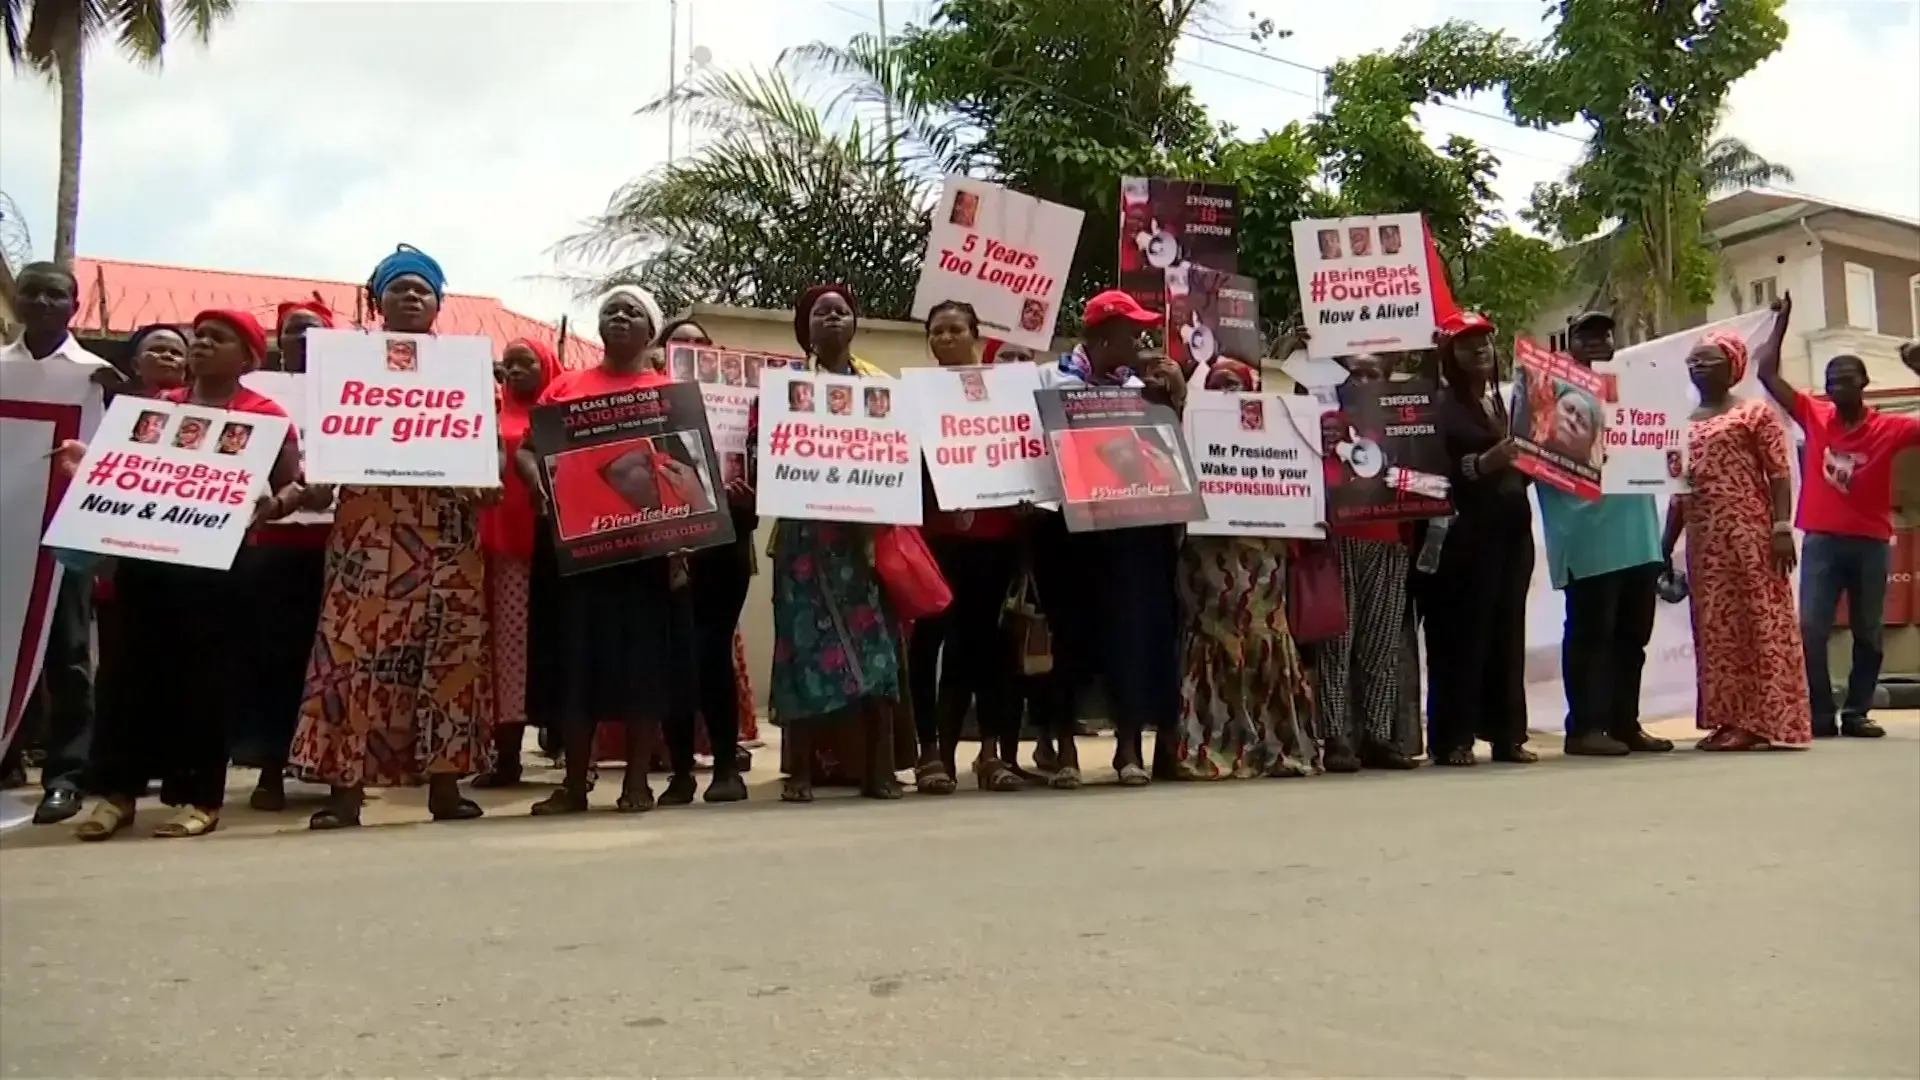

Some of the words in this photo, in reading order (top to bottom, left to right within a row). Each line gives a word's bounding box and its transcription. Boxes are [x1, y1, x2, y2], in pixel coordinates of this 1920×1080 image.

[962, 233, 979, 253] 5
[984, 237, 1039, 270] Years
[938, 249, 972, 276] Too
[976, 261, 1053, 296] Long!!!
[1319, 308, 1355, 325] Now
[1360, 305, 1371, 321] &
[1376, 302, 1419, 319] Alive!
[340, 380, 465, 409] Rescue
[610, 394, 636, 406] FIND
[321, 414, 383, 436] our
[391, 412, 483, 442] girls!
[941, 413, 1030, 438] Rescue
[1615, 409, 1626, 426] 5
[1629, 408, 1666, 426] Years
[936, 445, 976, 466] our
[986, 433, 1049, 468] girls!
[1604, 428, 1627, 444] Too
[1631, 429, 1679, 450] Long!!!
[1208, 443, 1227, 457] Mr
[1231, 444, 1298, 460] President!
[774, 464, 820, 482] Now
[826, 465, 841, 484] &
[847, 469, 904, 488] Alive!
[1200, 462, 1238, 476] Wake
[1241, 466, 1258, 478] up
[1262, 465, 1275, 477] to
[1279, 468, 1308, 480] your
[1199, 480, 1312, 497] RESPONSIBILITY!
[80, 492, 134, 517] Now
[137, 501, 157, 520] &
[160, 505, 231, 530] Alive!
